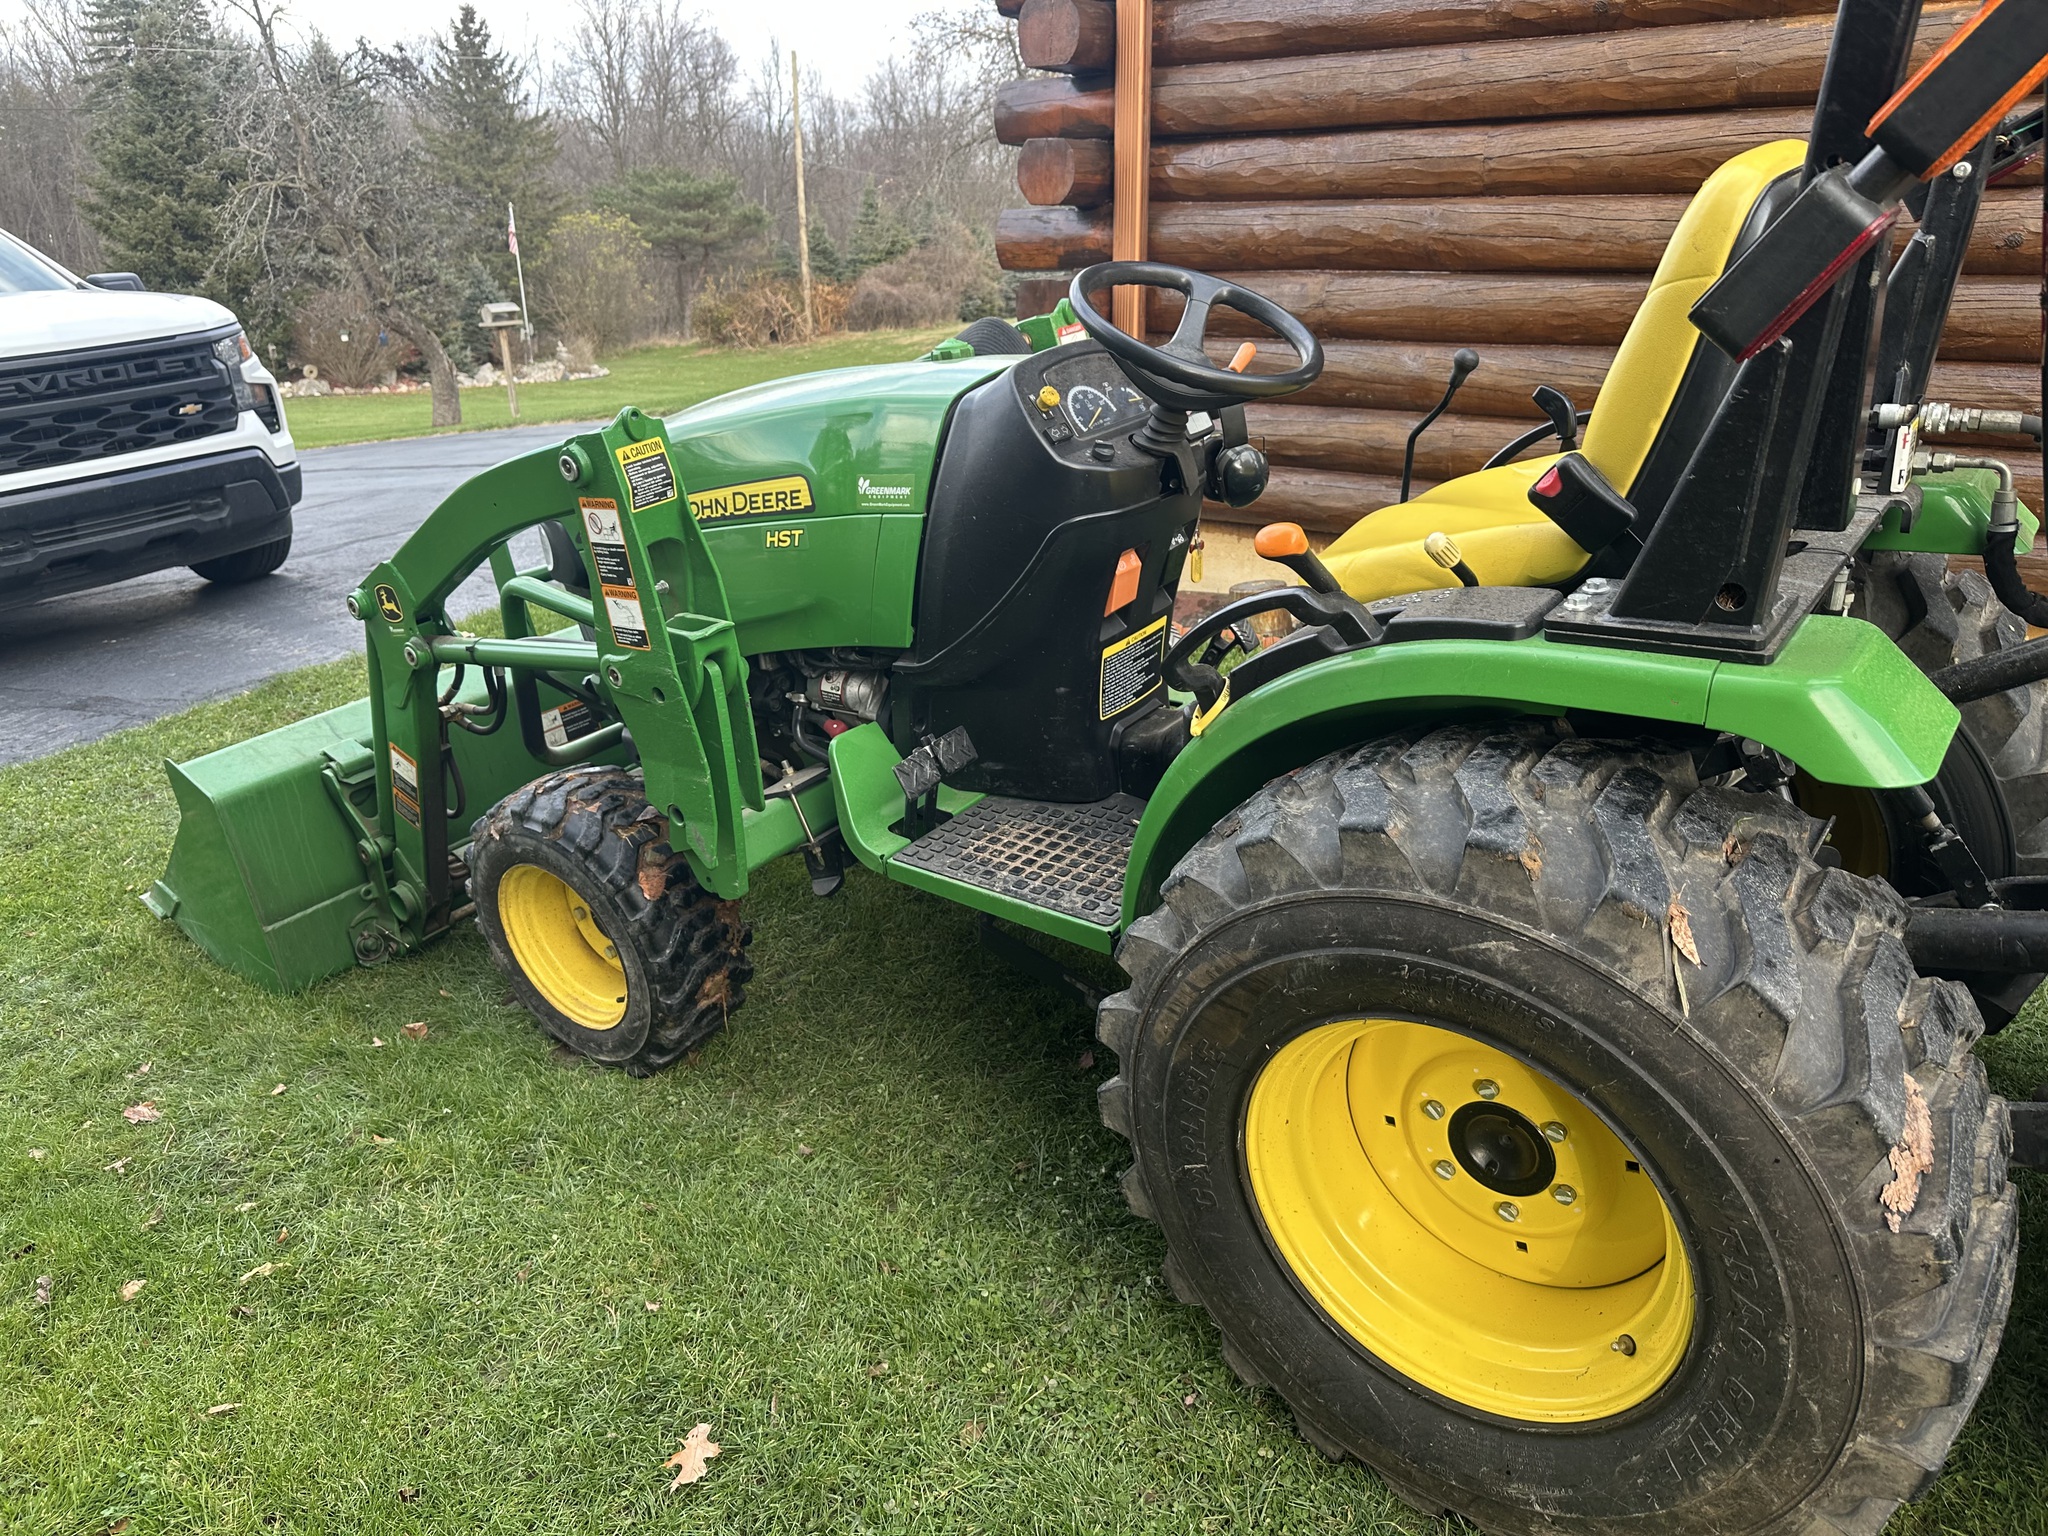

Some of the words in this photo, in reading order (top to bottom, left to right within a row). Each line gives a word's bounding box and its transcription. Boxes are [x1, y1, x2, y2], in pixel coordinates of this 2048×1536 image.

[630, 440, 662, 458] CAUTION
[865, 486, 911, 495] GREENMARK
[587, 500, 615, 509] WARNING
[690, 497, 728, 517] OHN
[732, 489, 802, 512] DEERE
[766, 529, 804, 548] HST
[608, 589, 637, 599] WARNING
